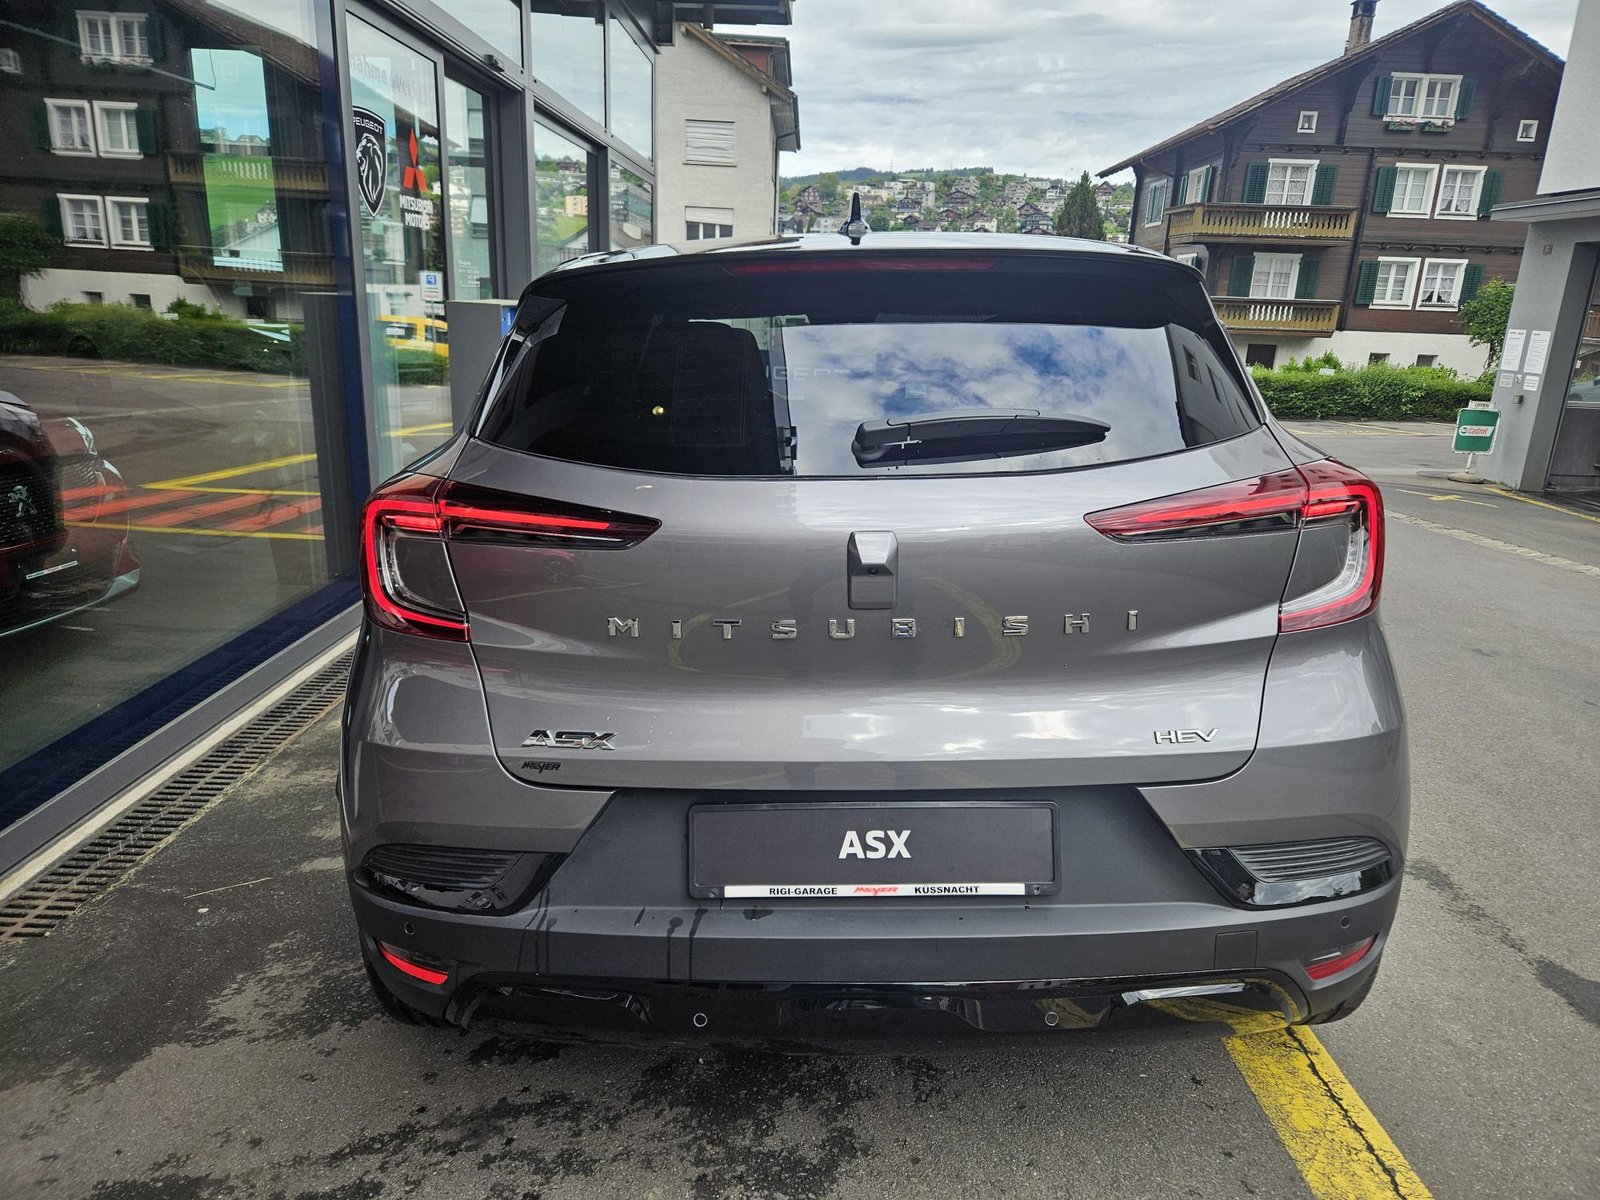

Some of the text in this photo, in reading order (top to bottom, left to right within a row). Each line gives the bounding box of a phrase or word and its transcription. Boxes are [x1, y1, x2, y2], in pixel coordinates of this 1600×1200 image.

[400, 194, 434, 214] MITSUBISHI
[405, 212, 431, 230] MOTORS
[1467, 427, 1488, 435] Castrol
[607, 610, 1139, 640] MITSUBISHI
[521, 729, 618, 750] ASX
[1154, 728, 1219, 744] HEV
[838, 830, 912, 859] ASX
[769, 887, 838, 896] RIGI-GARAGE
